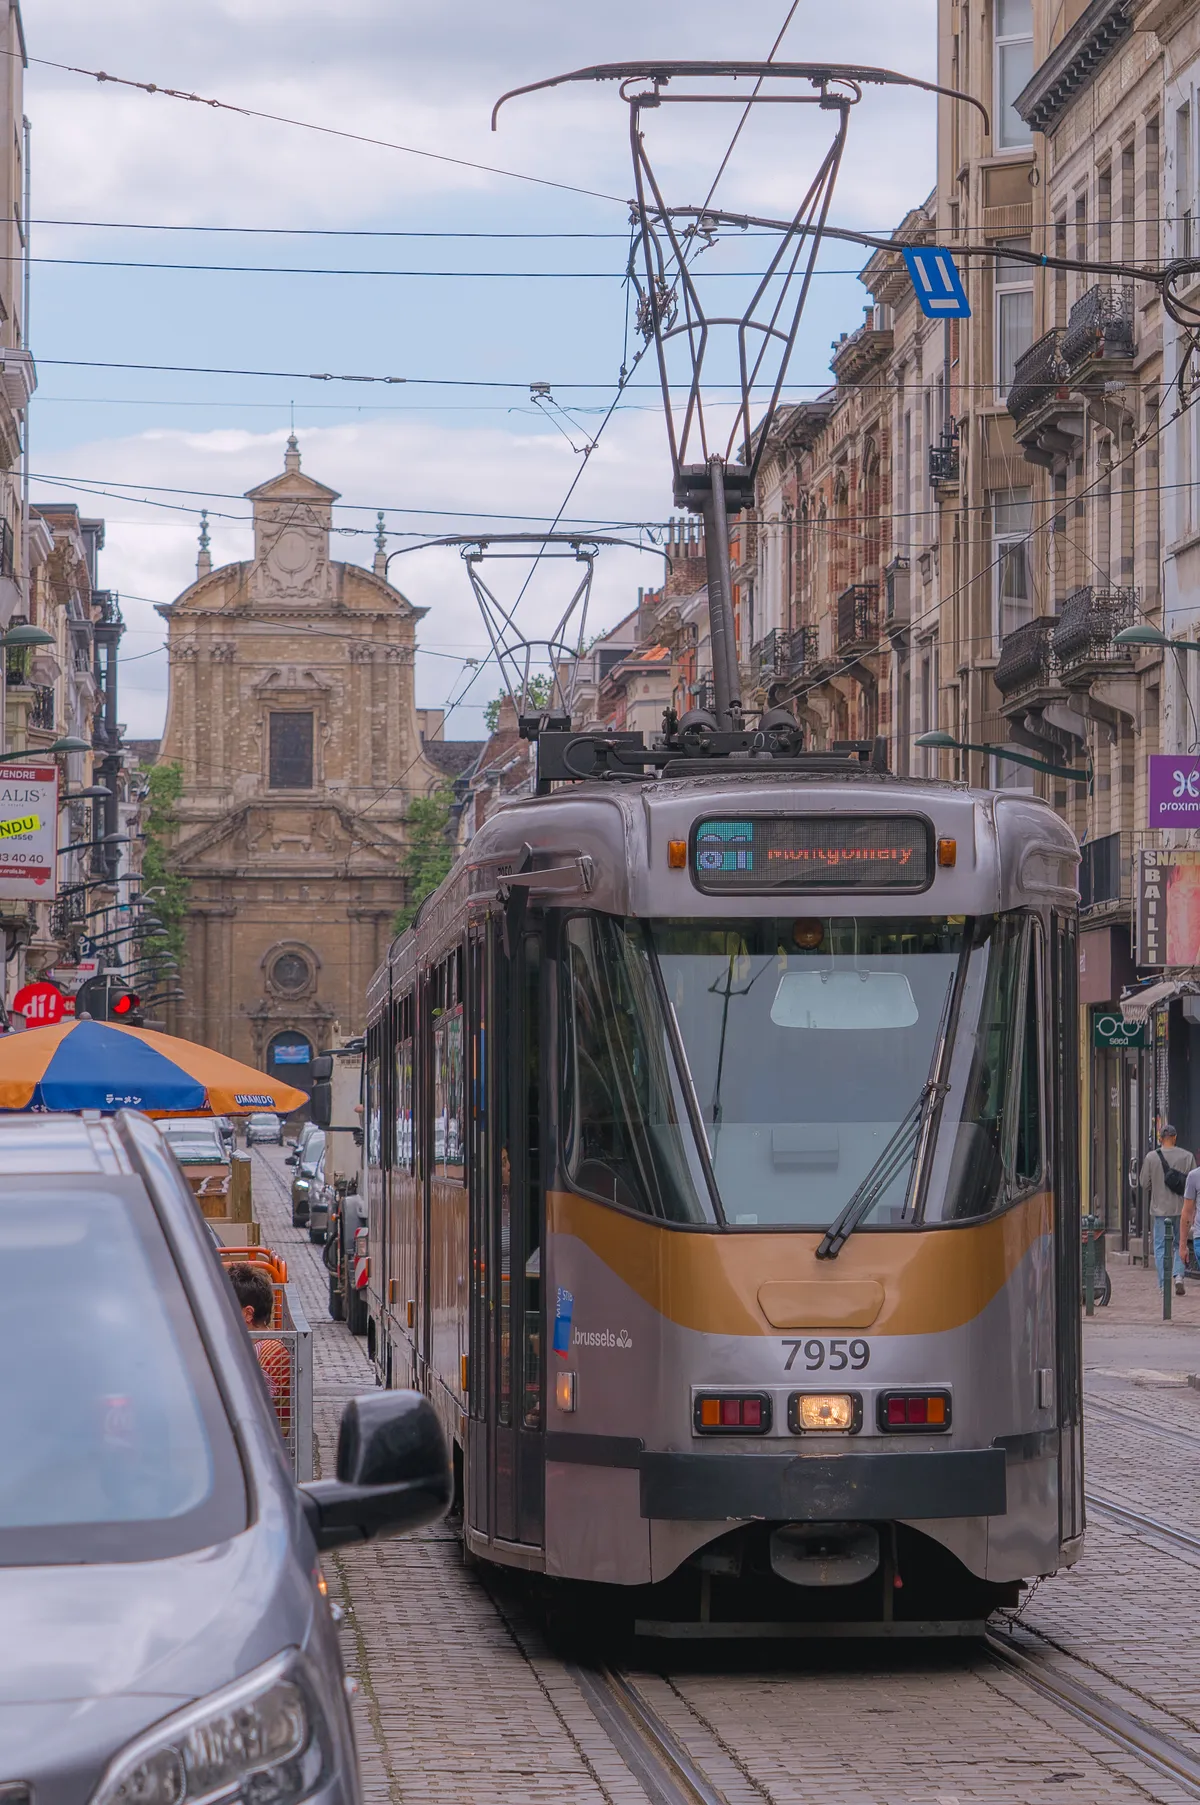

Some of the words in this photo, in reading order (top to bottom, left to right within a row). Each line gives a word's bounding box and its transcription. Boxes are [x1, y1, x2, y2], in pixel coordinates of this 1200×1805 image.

[1159, 802, 1200, 813] proxim
[11, 853, 27, 863] 40
[28, 854, 44, 864] 40
[1109, 1036, 1129, 1046] seed
[106, 1093, 142, 1105] ラーメン
[781, 1338, 871, 1371] 7959
